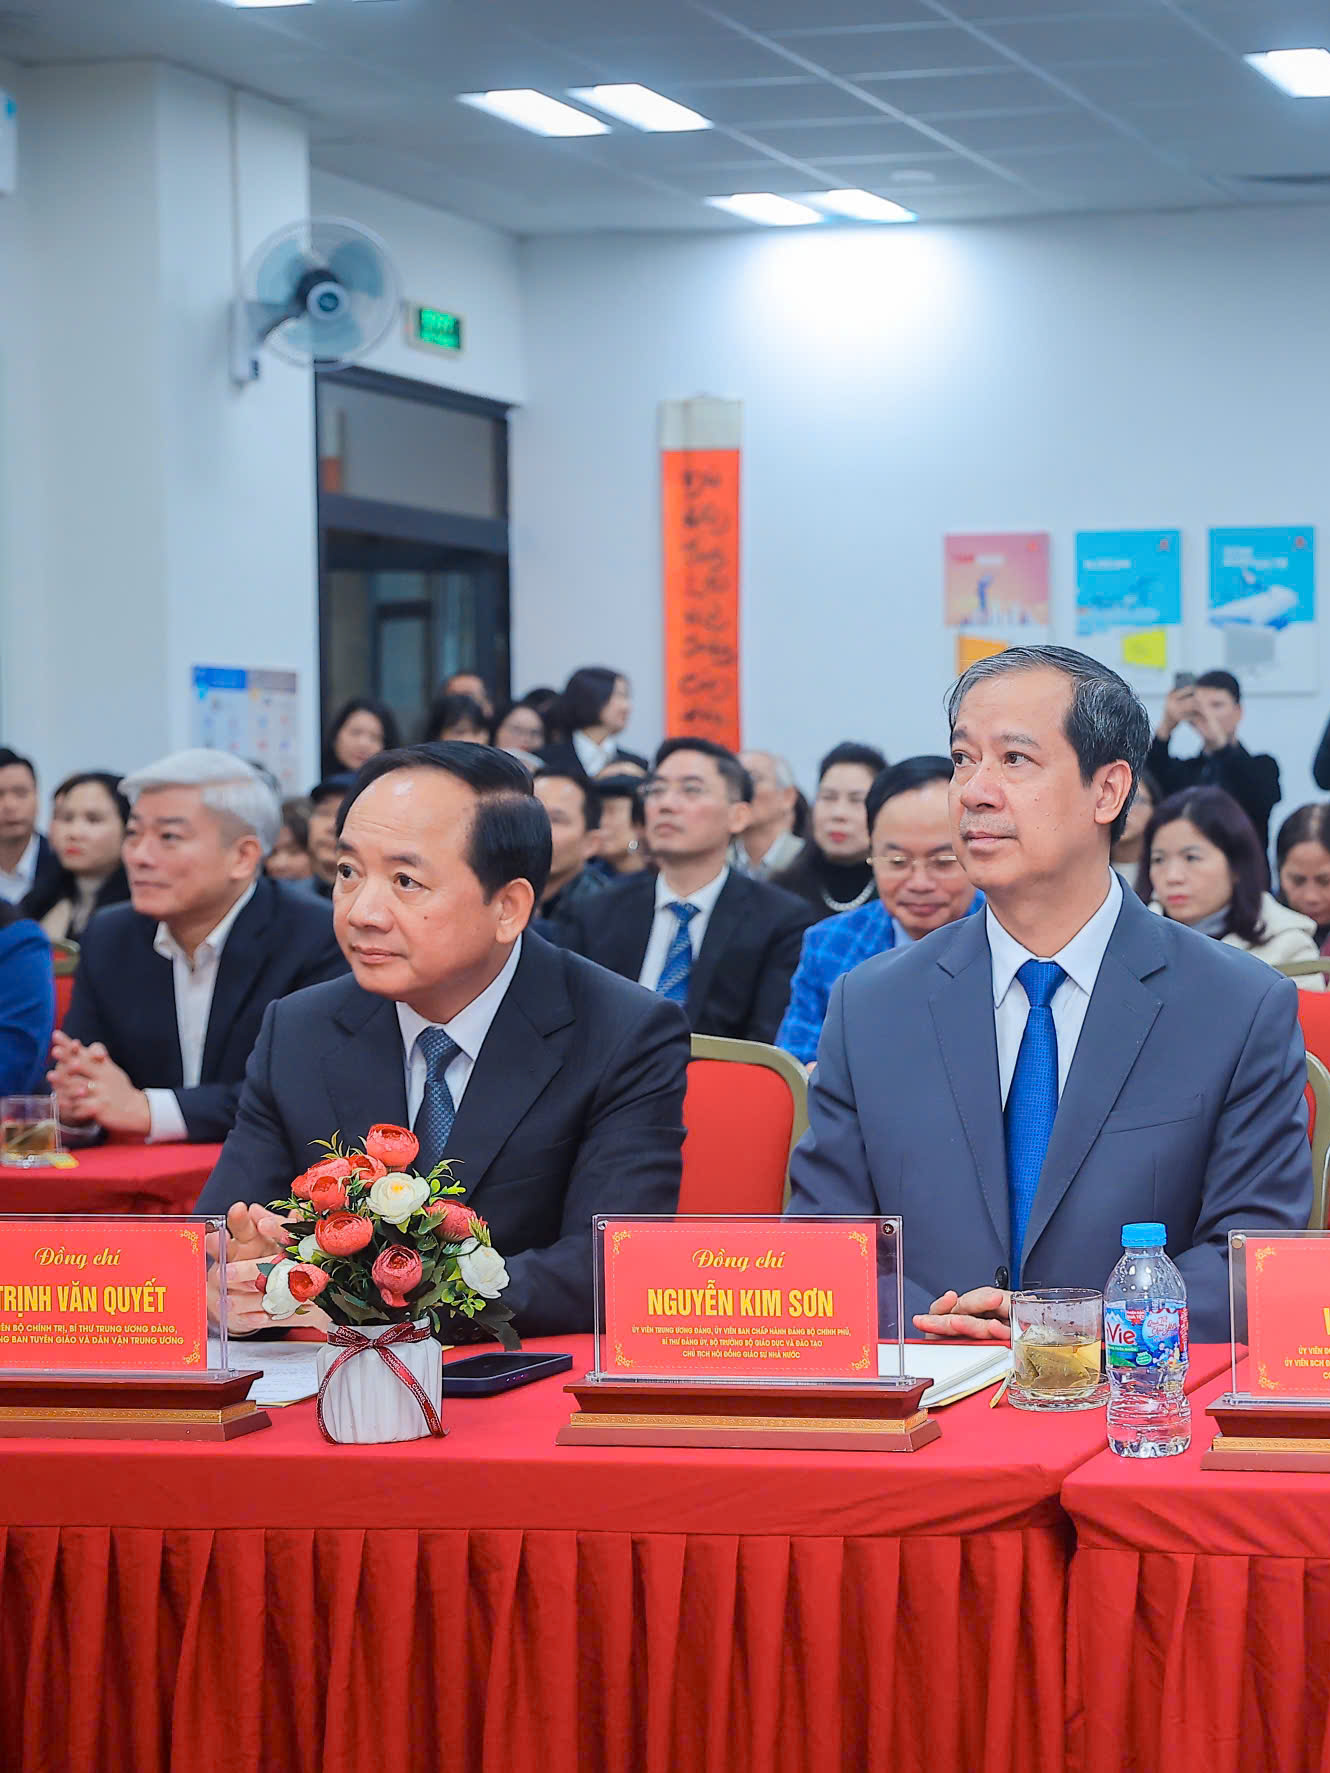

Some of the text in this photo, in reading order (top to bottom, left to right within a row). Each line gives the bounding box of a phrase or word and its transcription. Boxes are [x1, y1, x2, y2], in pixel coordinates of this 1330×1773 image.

[34, 1246, 122, 1269] Đồng chí
[692, 1249, 786, 1272] Đồng chí
[56, 1280, 98, 1312] VĂN
[103, 1278, 167, 1316] QUYẾT
[647, 1279, 833, 1318] NGUYỄN KIM SƠN
[1106, 1321, 1136, 1345] Vie
[385, 1353, 401, 1371] CHANEL
[411, 1383, 426, 1404] CHANEL
